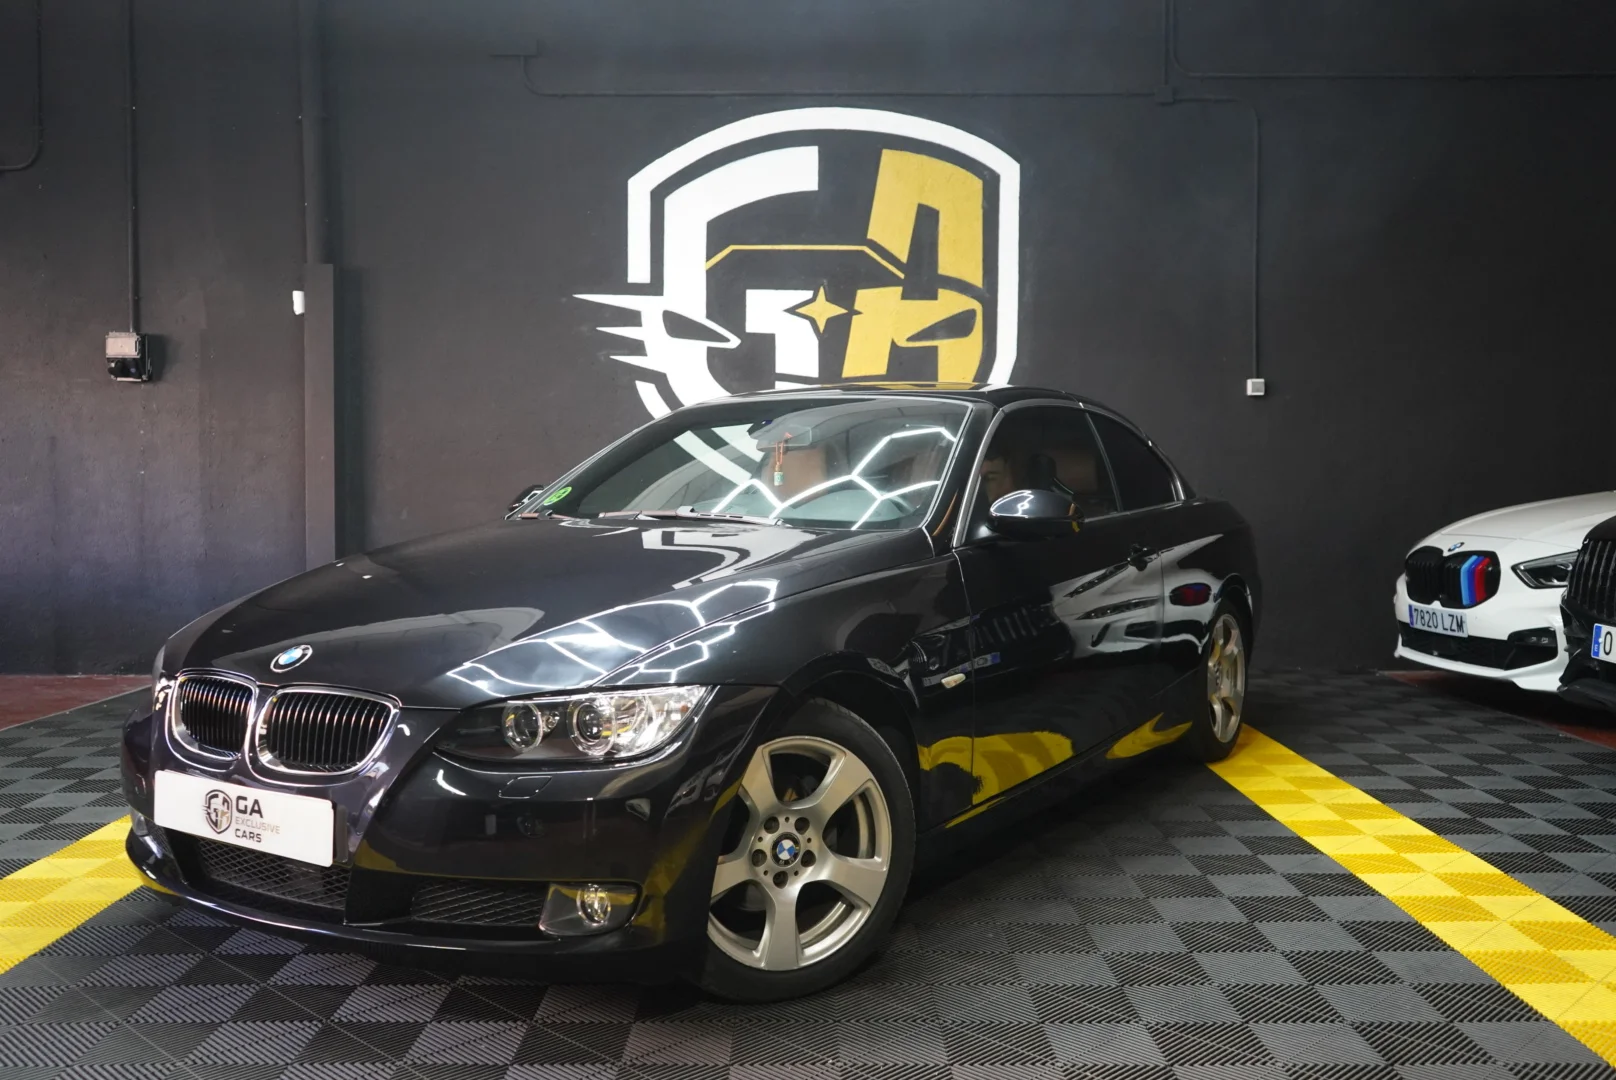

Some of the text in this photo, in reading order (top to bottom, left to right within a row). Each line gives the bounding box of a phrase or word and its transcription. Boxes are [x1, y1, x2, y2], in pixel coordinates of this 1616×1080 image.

[1414, 608, 1465, 634] 7820 LZM
[235, 795, 264, 819] GA
[235, 816, 281, 835] EXCLUSIVE
[235, 828, 263, 843] CARS
